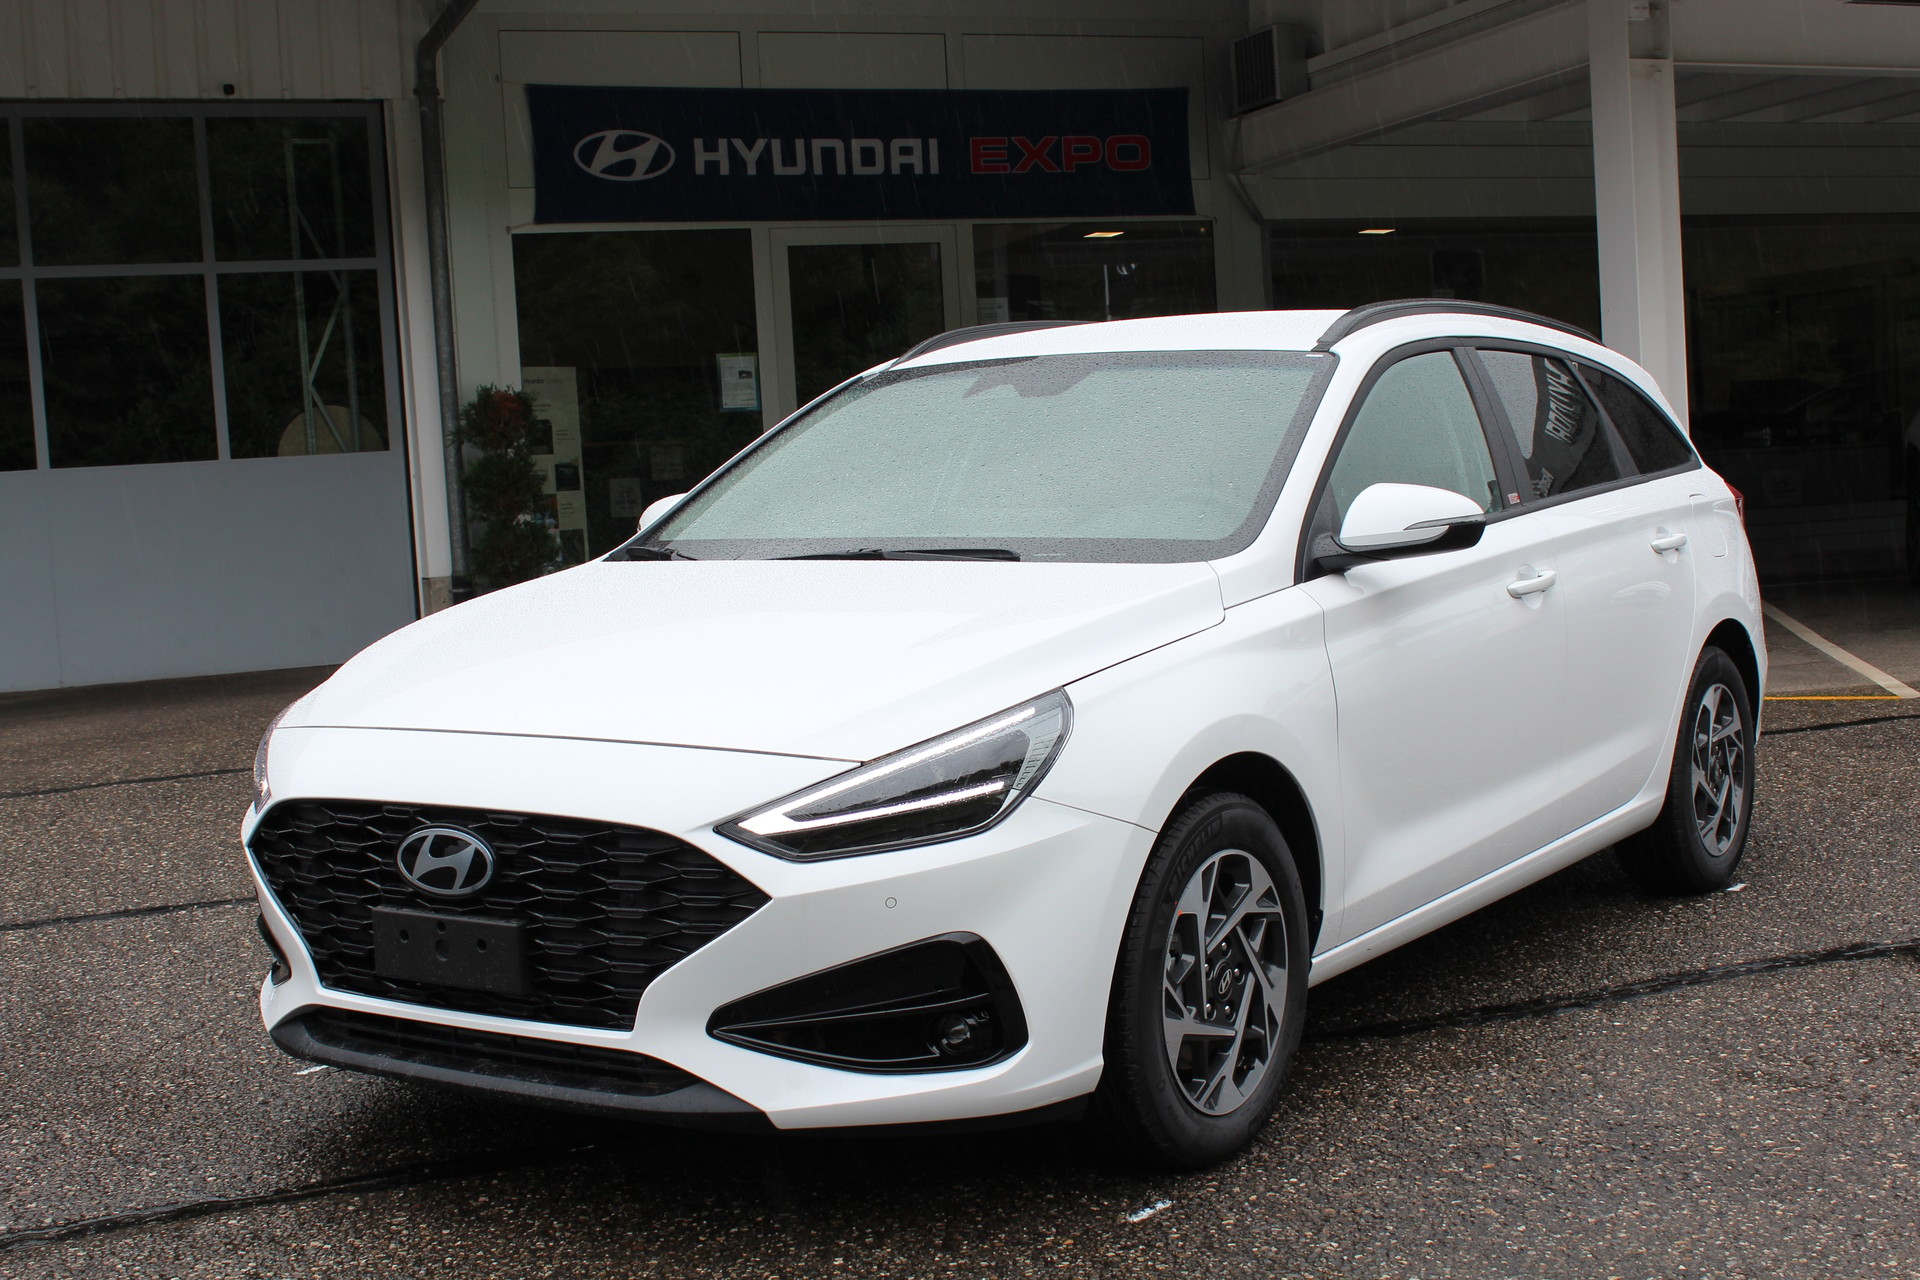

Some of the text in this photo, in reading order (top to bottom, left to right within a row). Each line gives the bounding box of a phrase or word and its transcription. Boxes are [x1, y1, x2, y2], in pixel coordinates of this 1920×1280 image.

[693, 134, 1151, 176] HYUNDAI EXPO
[1168, 818, 1221, 898] MICHELIN
